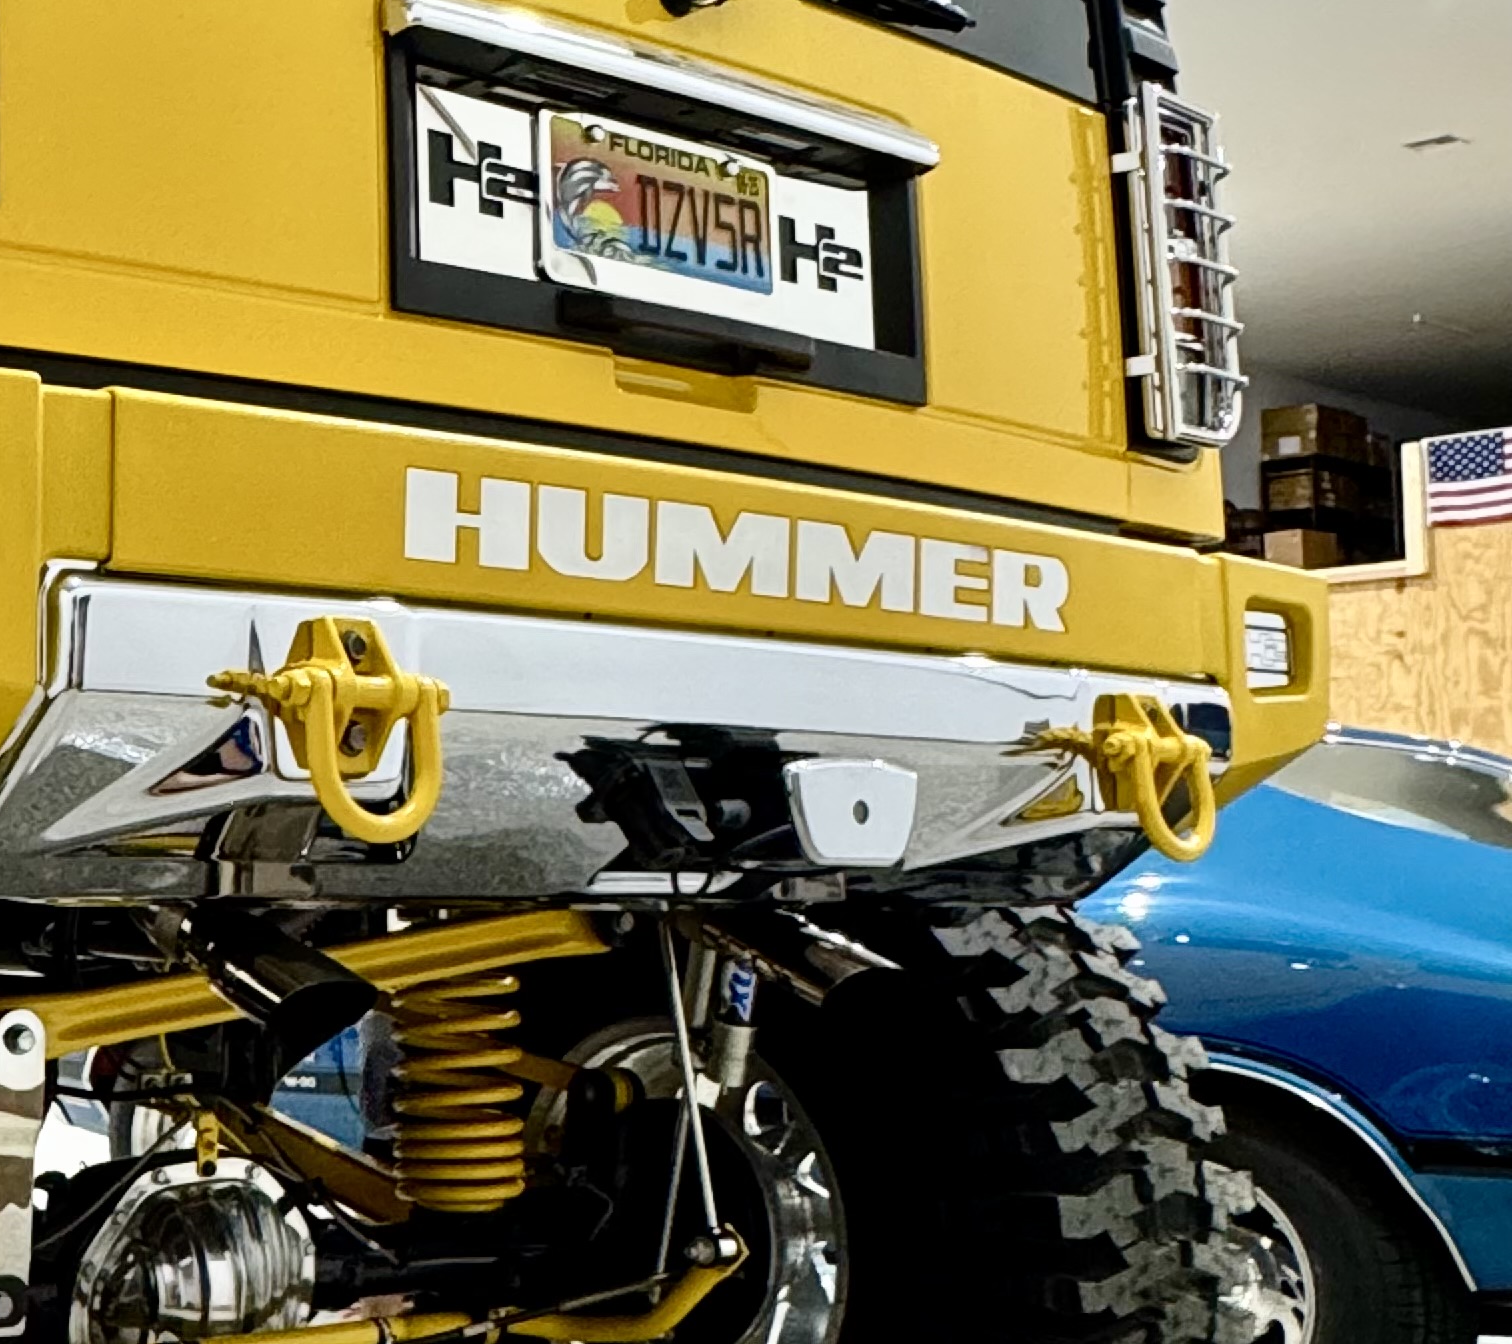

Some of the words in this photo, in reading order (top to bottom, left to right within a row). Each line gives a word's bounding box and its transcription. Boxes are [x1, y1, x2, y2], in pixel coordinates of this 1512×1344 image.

[427, 128, 539, 218] H2
[608, 136, 714, 178] FLORIDA
[778, 215, 864, 294] H2
[404, 467, 1069, 633] HUMMER
